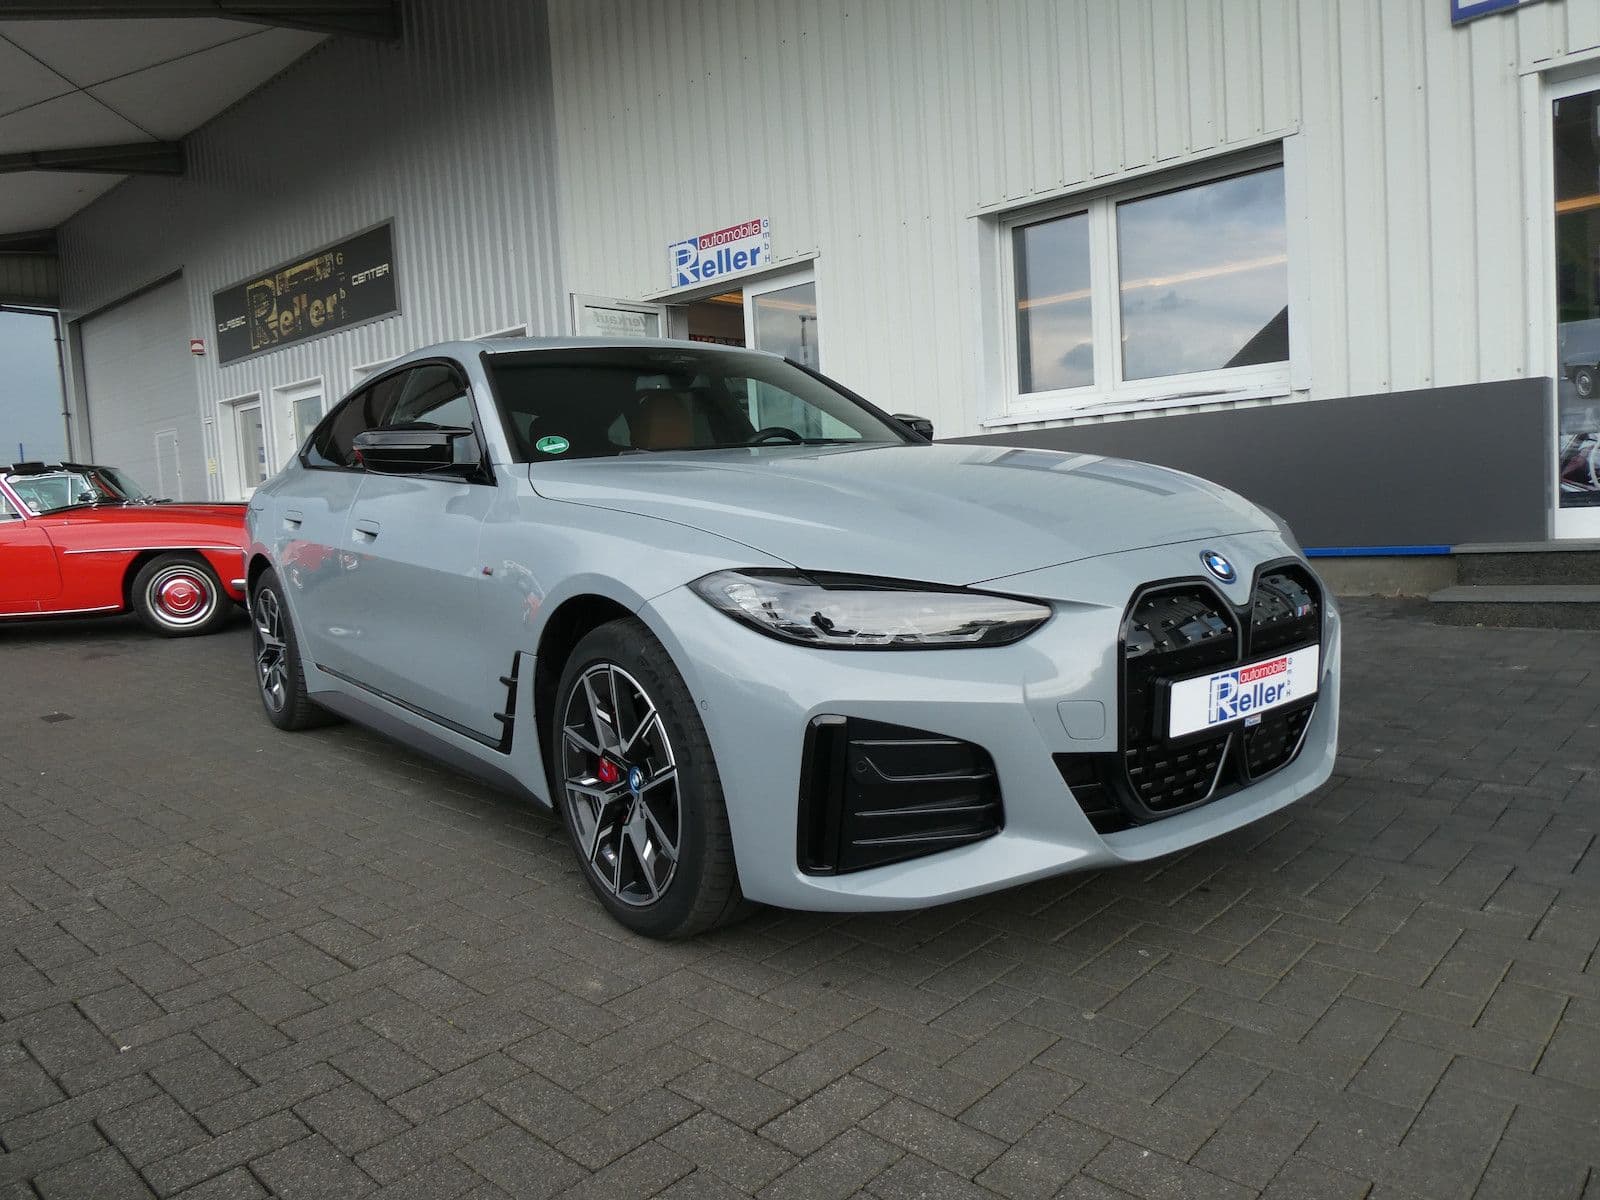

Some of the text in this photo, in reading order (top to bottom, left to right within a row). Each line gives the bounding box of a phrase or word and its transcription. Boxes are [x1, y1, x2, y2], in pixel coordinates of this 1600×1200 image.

[700, 222, 760, 249] automobile
[762, 219, 771, 263] GmbH
[351, 263, 390, 287] CENTER
[669, 237, 760, 288] Reller
[1240, 660, 1287, 683] automobile
[1209, 671, 1285, 724] Reller
